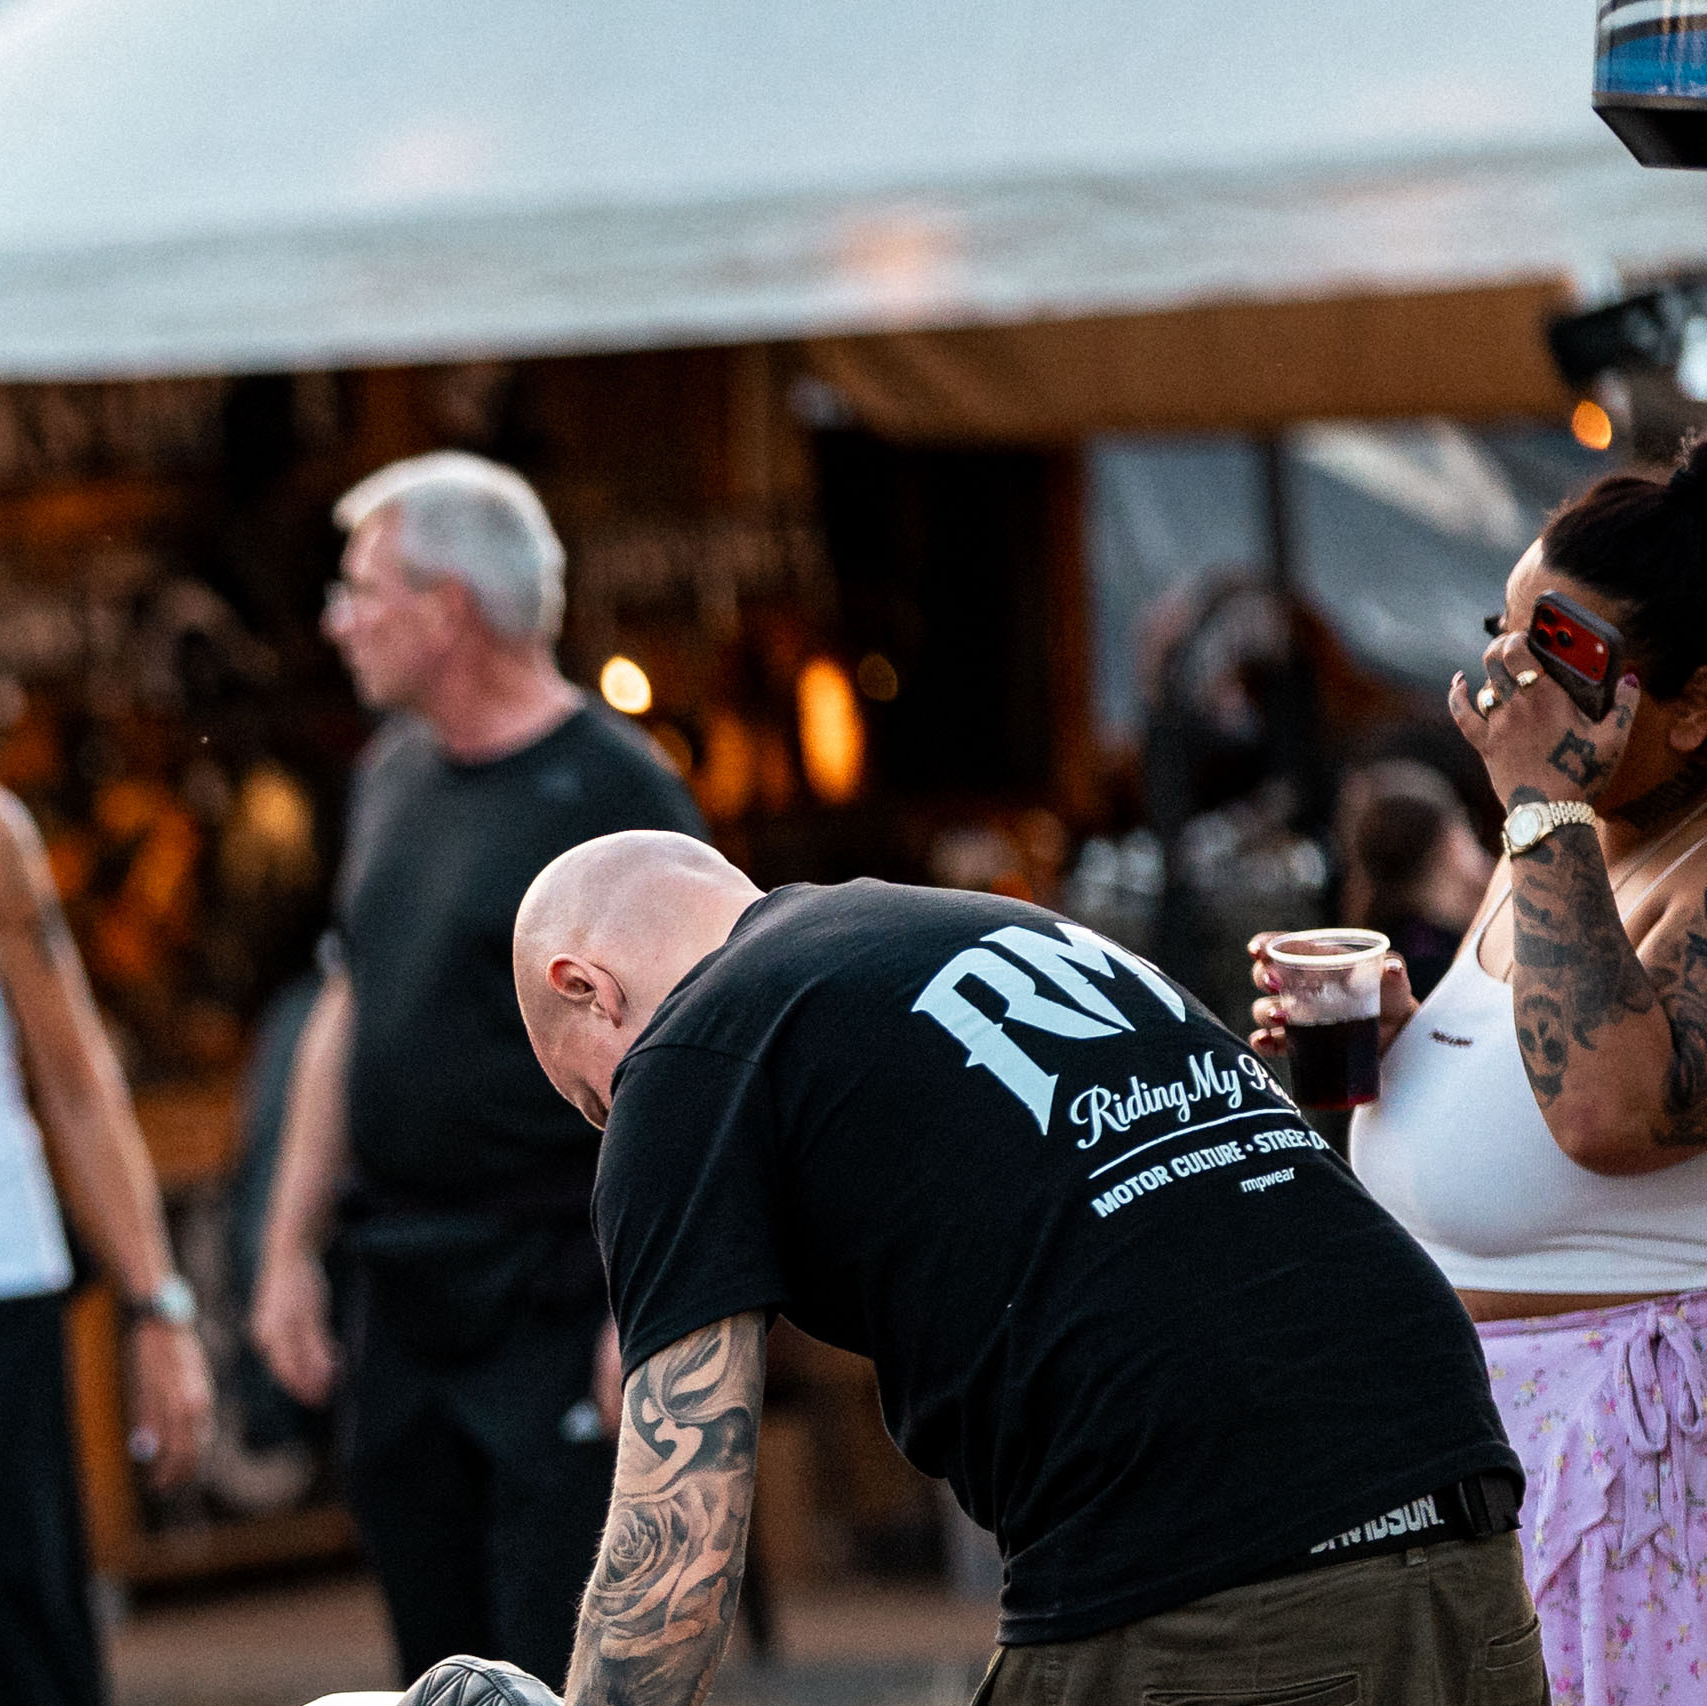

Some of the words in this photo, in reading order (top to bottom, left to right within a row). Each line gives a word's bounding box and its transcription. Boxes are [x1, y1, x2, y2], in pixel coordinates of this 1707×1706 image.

[1069, 1075, 1191, 1149] Riding
[1187, 1051, 1243, 1109] My
[1091, 1165, 1174, 1218] MOTOR
[1170, 1141, 1247, 1177] CULTURE
[1240, 1167, 1295, 1193] rmpwear
